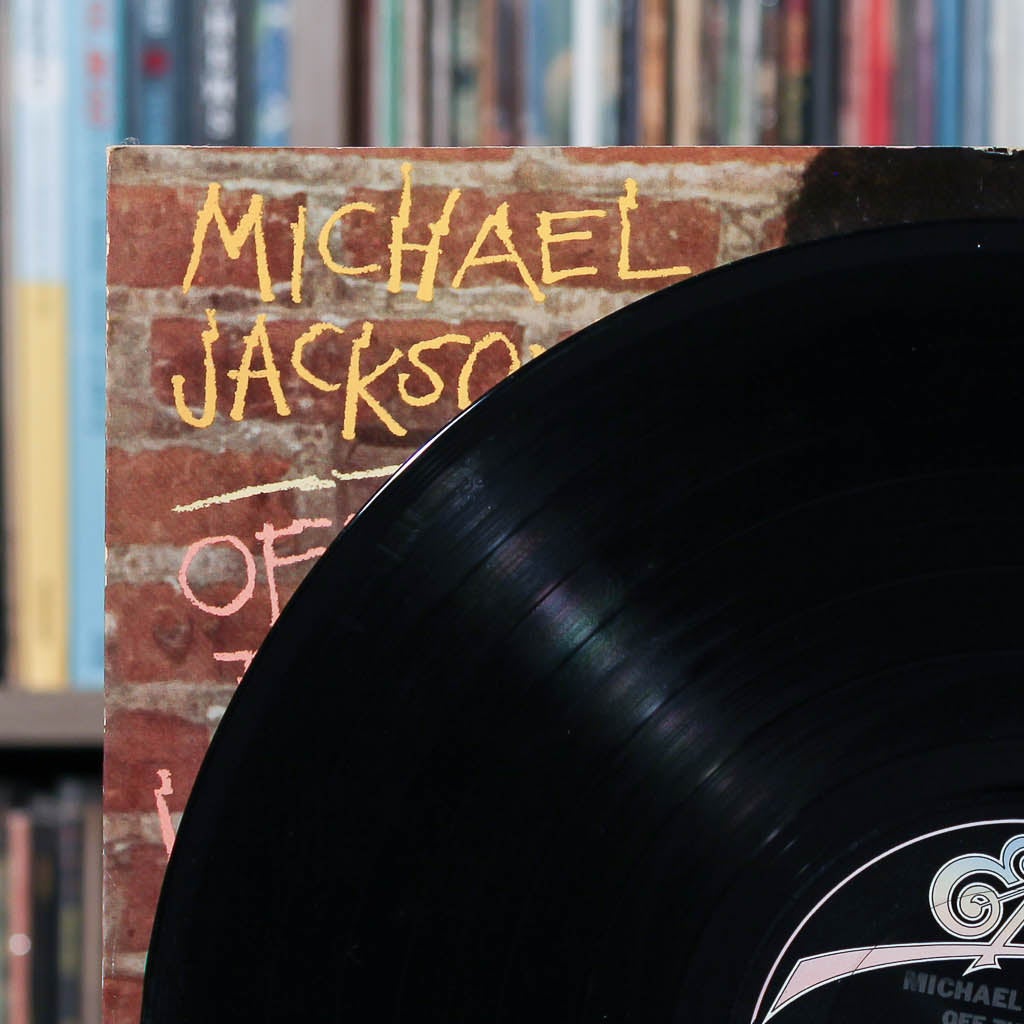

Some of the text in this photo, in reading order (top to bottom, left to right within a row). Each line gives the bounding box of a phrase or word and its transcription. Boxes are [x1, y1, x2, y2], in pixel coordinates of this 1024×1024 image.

[182, 162, 691, 303] MICHAEL
[171, 308, 545, 440] JACKSO
[178, 512, 356, 626] OF
[902, 969, 1023, 1013] MICHAEL
